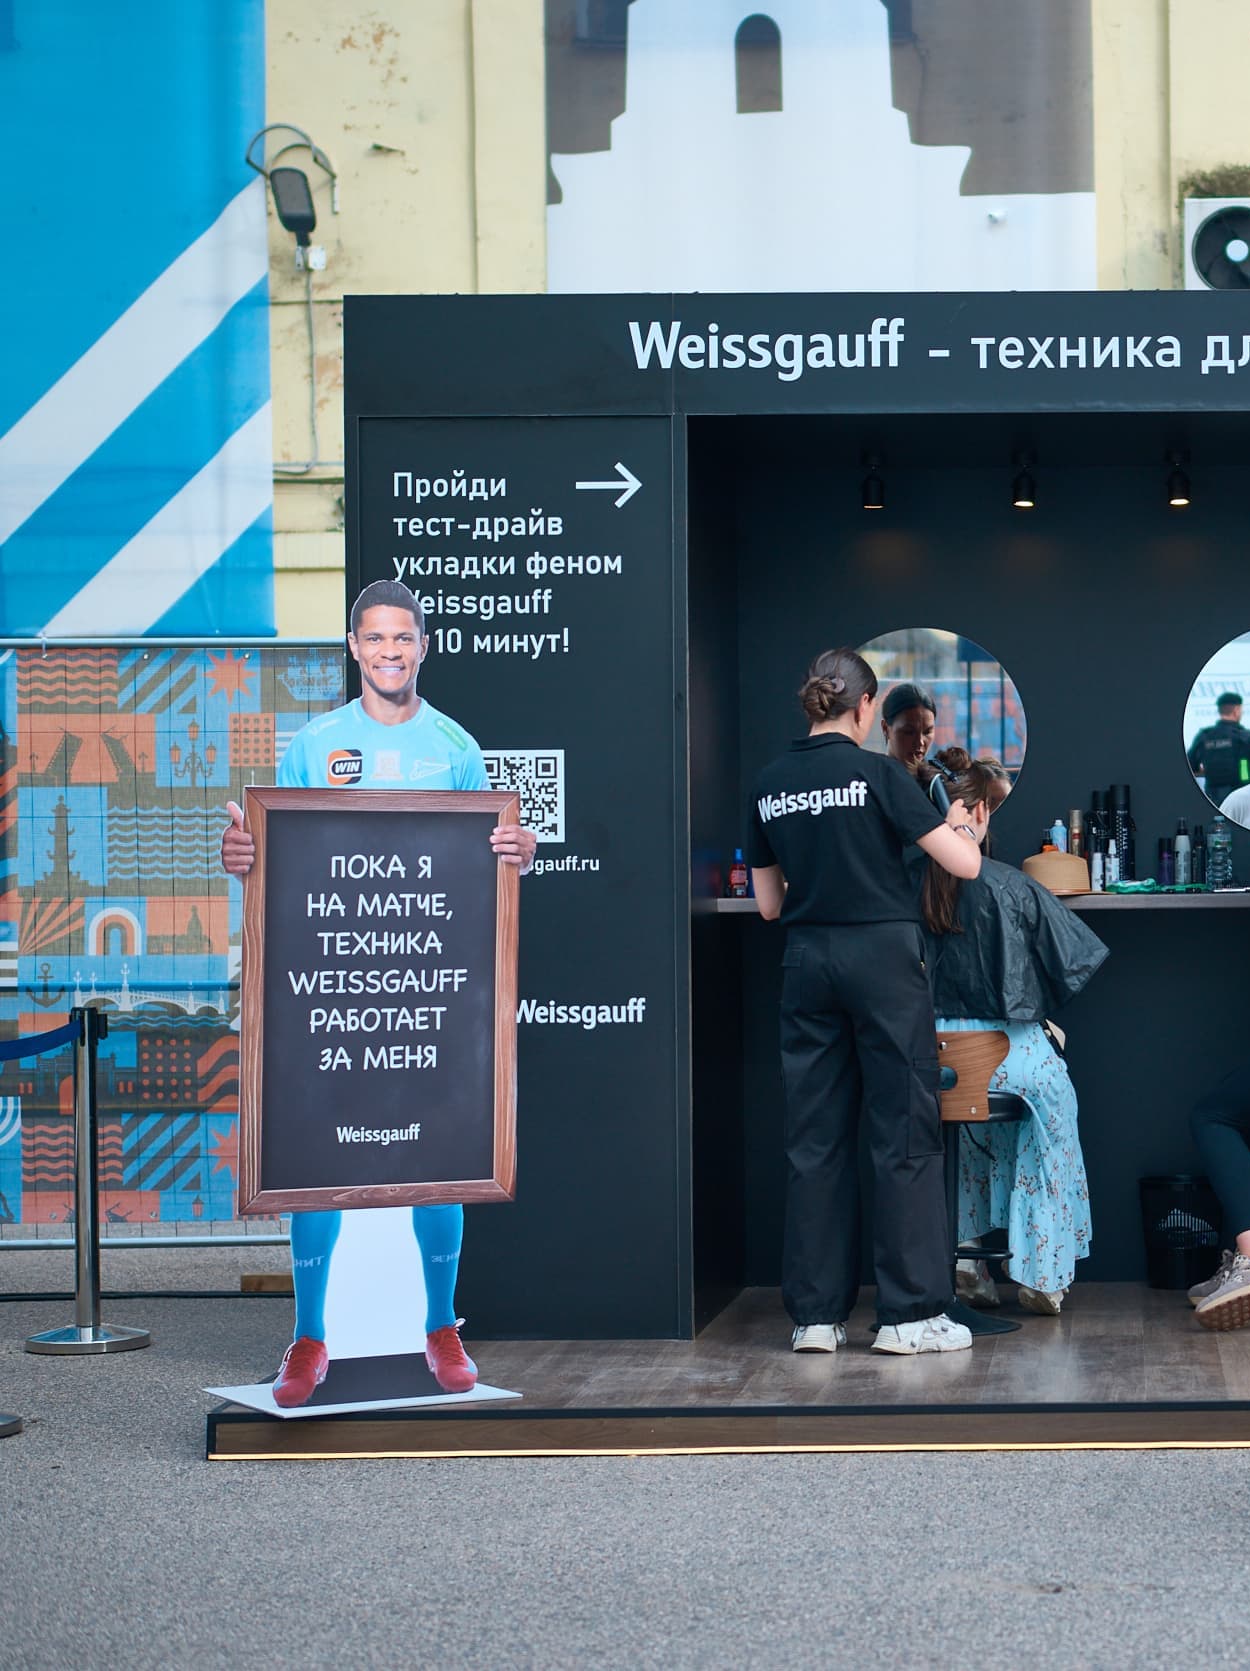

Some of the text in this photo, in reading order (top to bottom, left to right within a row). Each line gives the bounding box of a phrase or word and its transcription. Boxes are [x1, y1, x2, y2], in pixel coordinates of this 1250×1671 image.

[629, 317, 905, 381] Weissgauff
[970, 335, 1181, 369] техника
[393, 469, 506, 504] Пройди
[393, 508, 563, 542] тест-драйв
[393, 551, 622, 581] укладки феном
[434, 627, 569, 660] 10 минут!
[333, 761, 361, 774] WIN
[757, 780, 868, 824] Weissgauff
[331, 854, 433, 879] ПОКА Я
[307, 892, 454, 921] НА МАТЧЕ,
[316, 930, 443, 956] ТЕХНИКА
[288, 968, 468, 996] WEISSGAUFF
[309, 1006, 448, 1034] РАБОТАЕТ
[516, 997, 646, 1030] Weissgauff
[318, 1044, 438, 1071] ЗА МЕНЯ
[336, 1122, 421, 1145] Weissgauff
